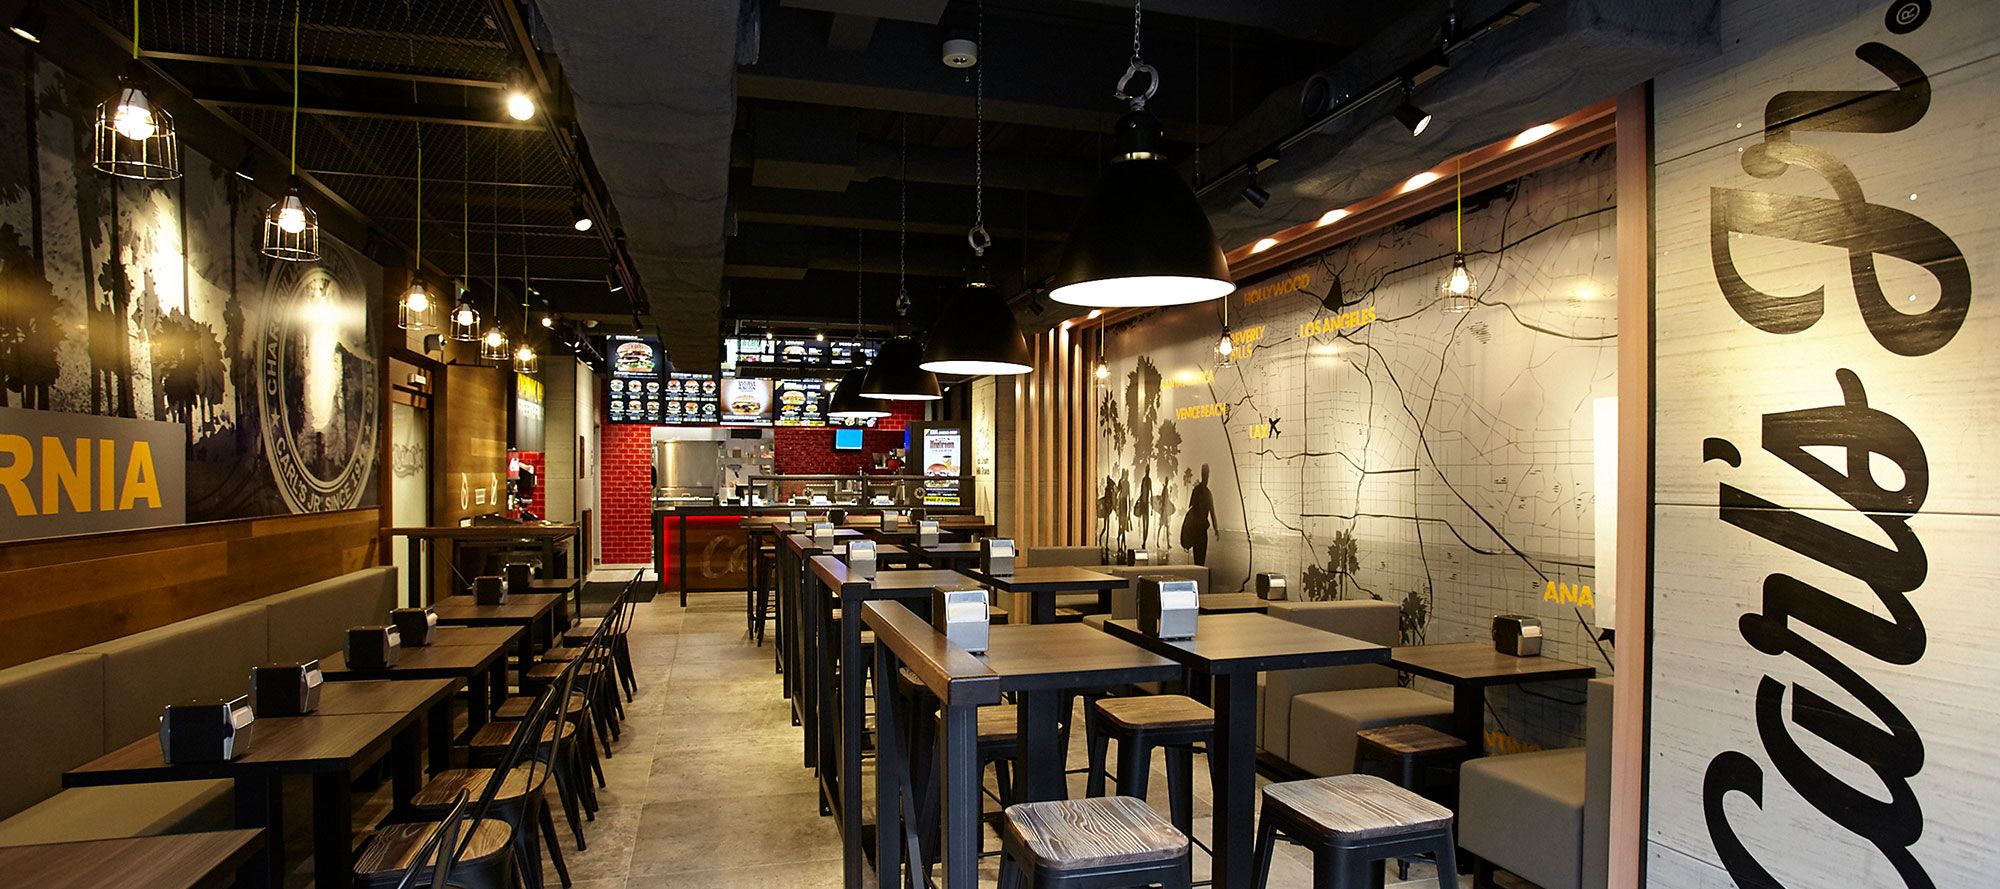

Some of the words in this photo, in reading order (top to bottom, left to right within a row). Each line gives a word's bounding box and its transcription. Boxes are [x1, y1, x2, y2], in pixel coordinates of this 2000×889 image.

[1244, 273, 1310, 307] HOLLYWOOD
[1300, 318, 1322, 339] LOS
[1322, 305, 1377, 335] ANGELES
[1176, 405, 1201, 421] VENICE
[1201, 402, 1226, 418] BEACH
[1249, 423, 1267, 440] LAX
[0, 434, 162, 516] RNIA
[276, 437, 308, 503] CARL'S
[324, 483, 352, 512] SINCE
[1543, 580, 1595, 608] ANA
